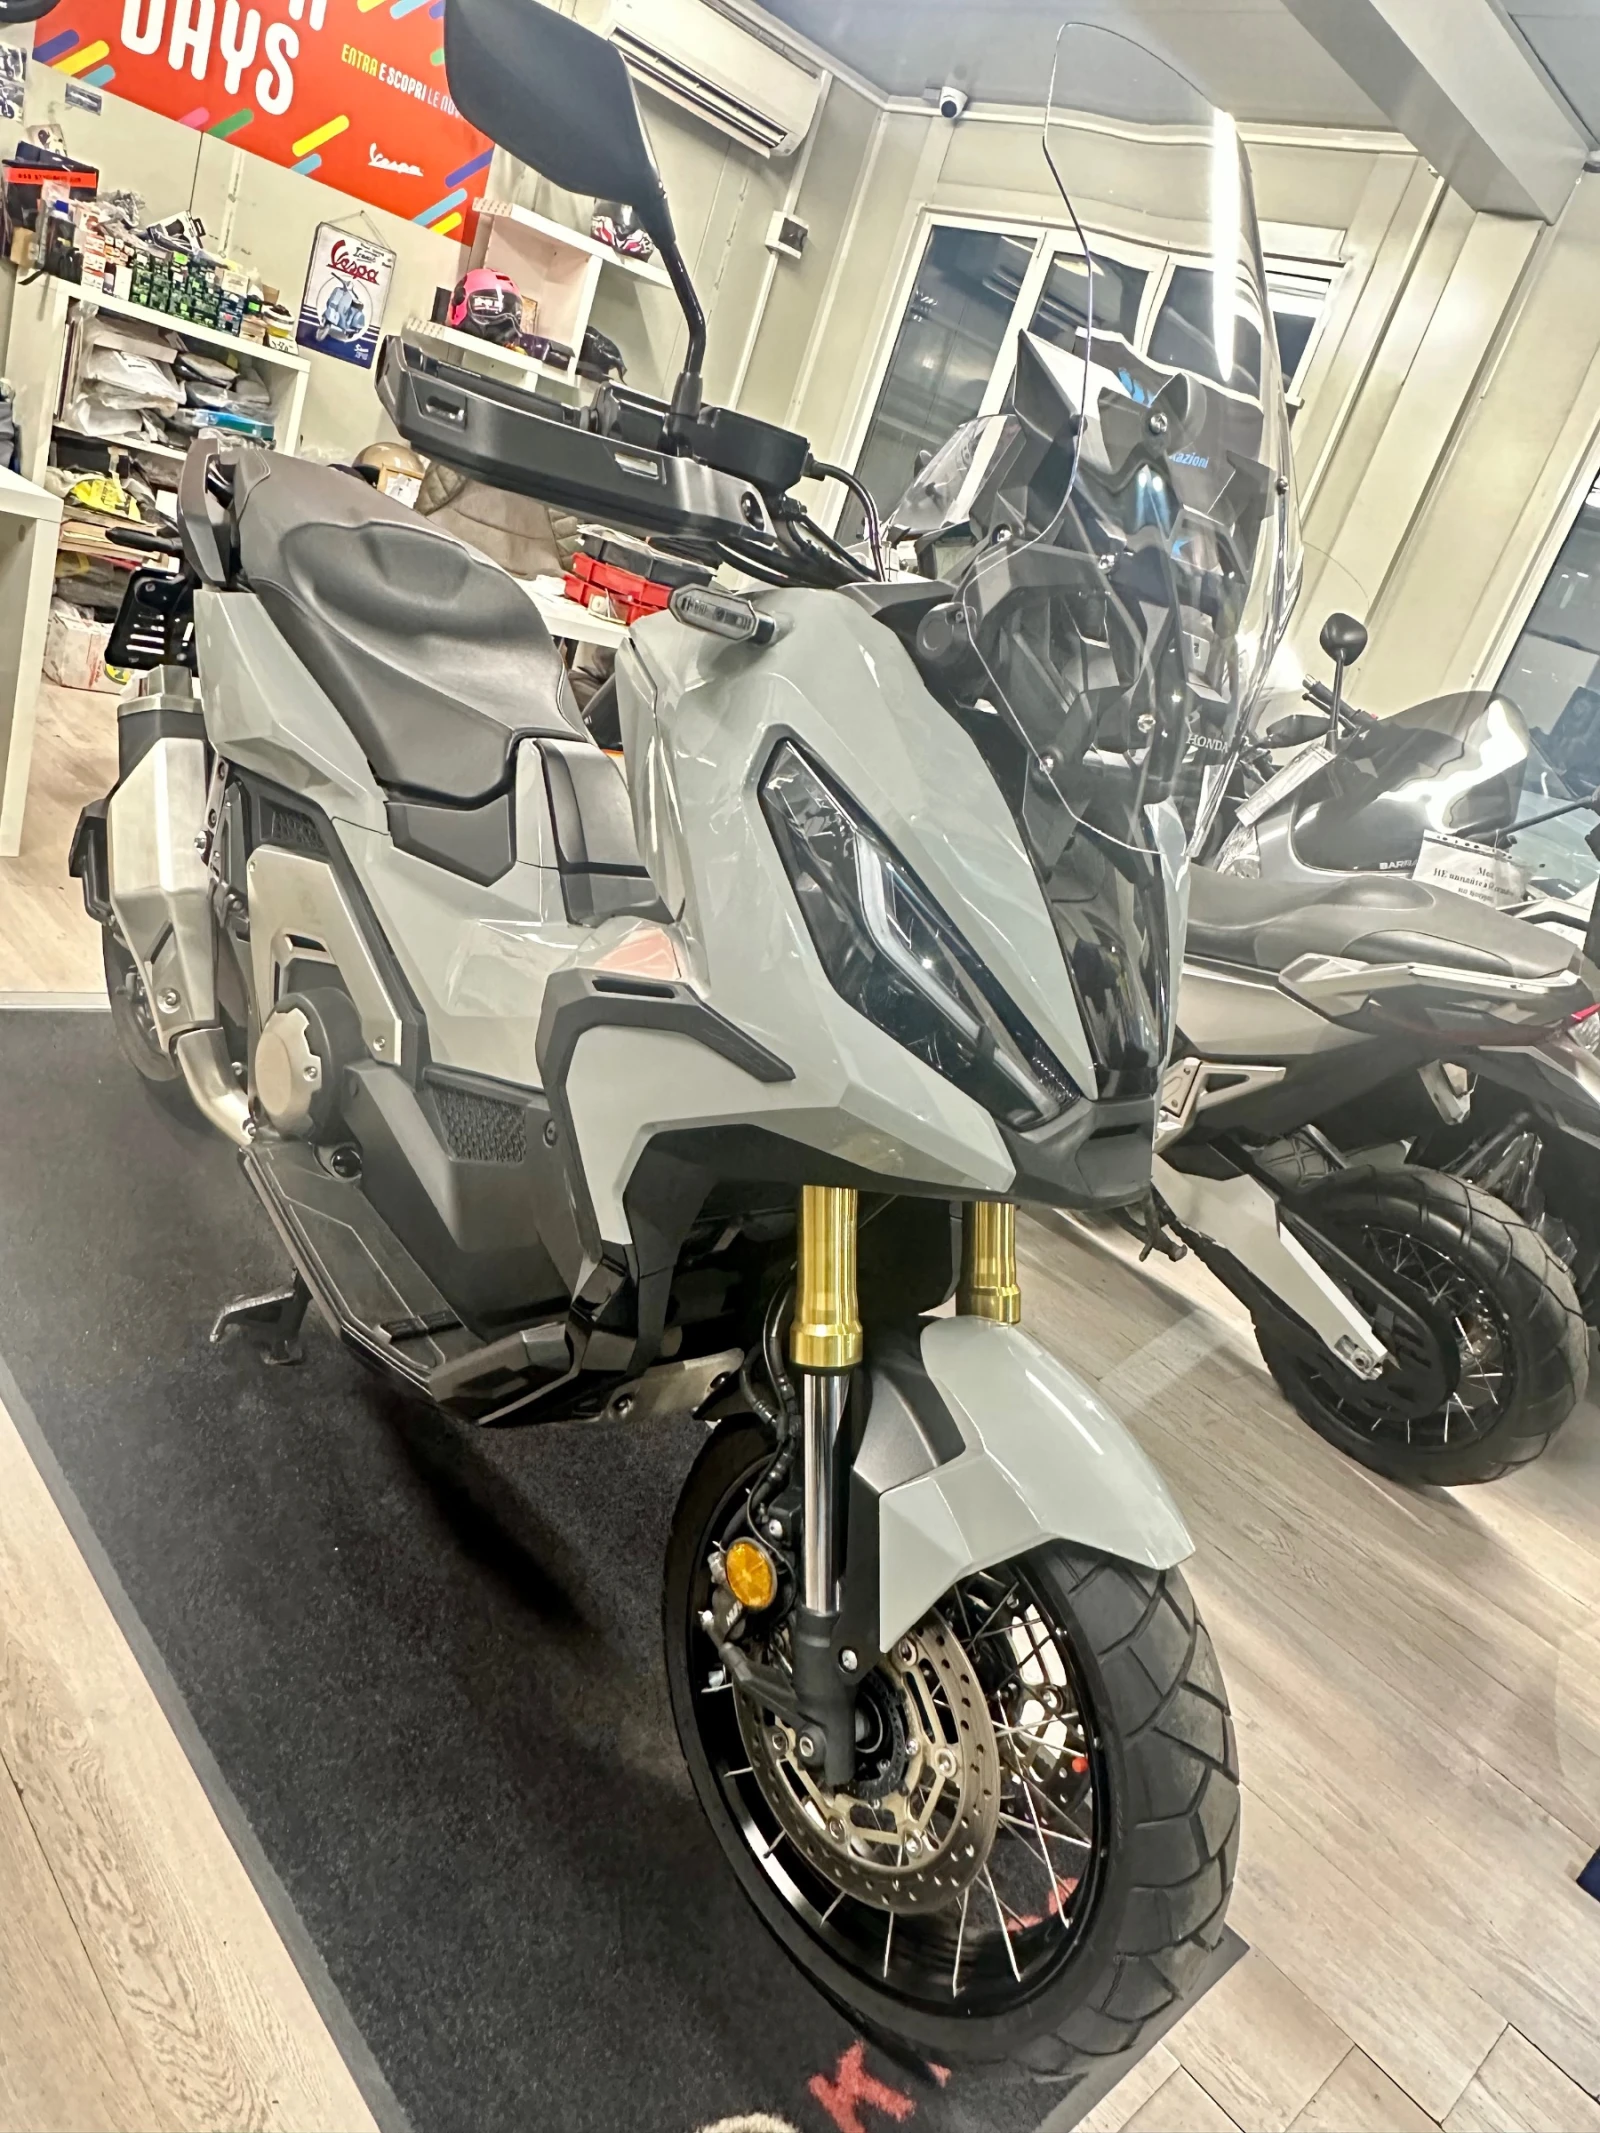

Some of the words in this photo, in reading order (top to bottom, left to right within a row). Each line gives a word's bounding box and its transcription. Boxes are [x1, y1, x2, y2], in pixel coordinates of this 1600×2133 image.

[341, 43, 379, 77] ENTRA
[378, 62, 388, 82] E
[386, 66, 427, 101] SCOPRI
[427, 87, 440, 109] LE
[367, 141, 424, 177] Vespa
[326, 239, 380, 285] Vespa
[1185, 733, 1229, 753] HONDA
